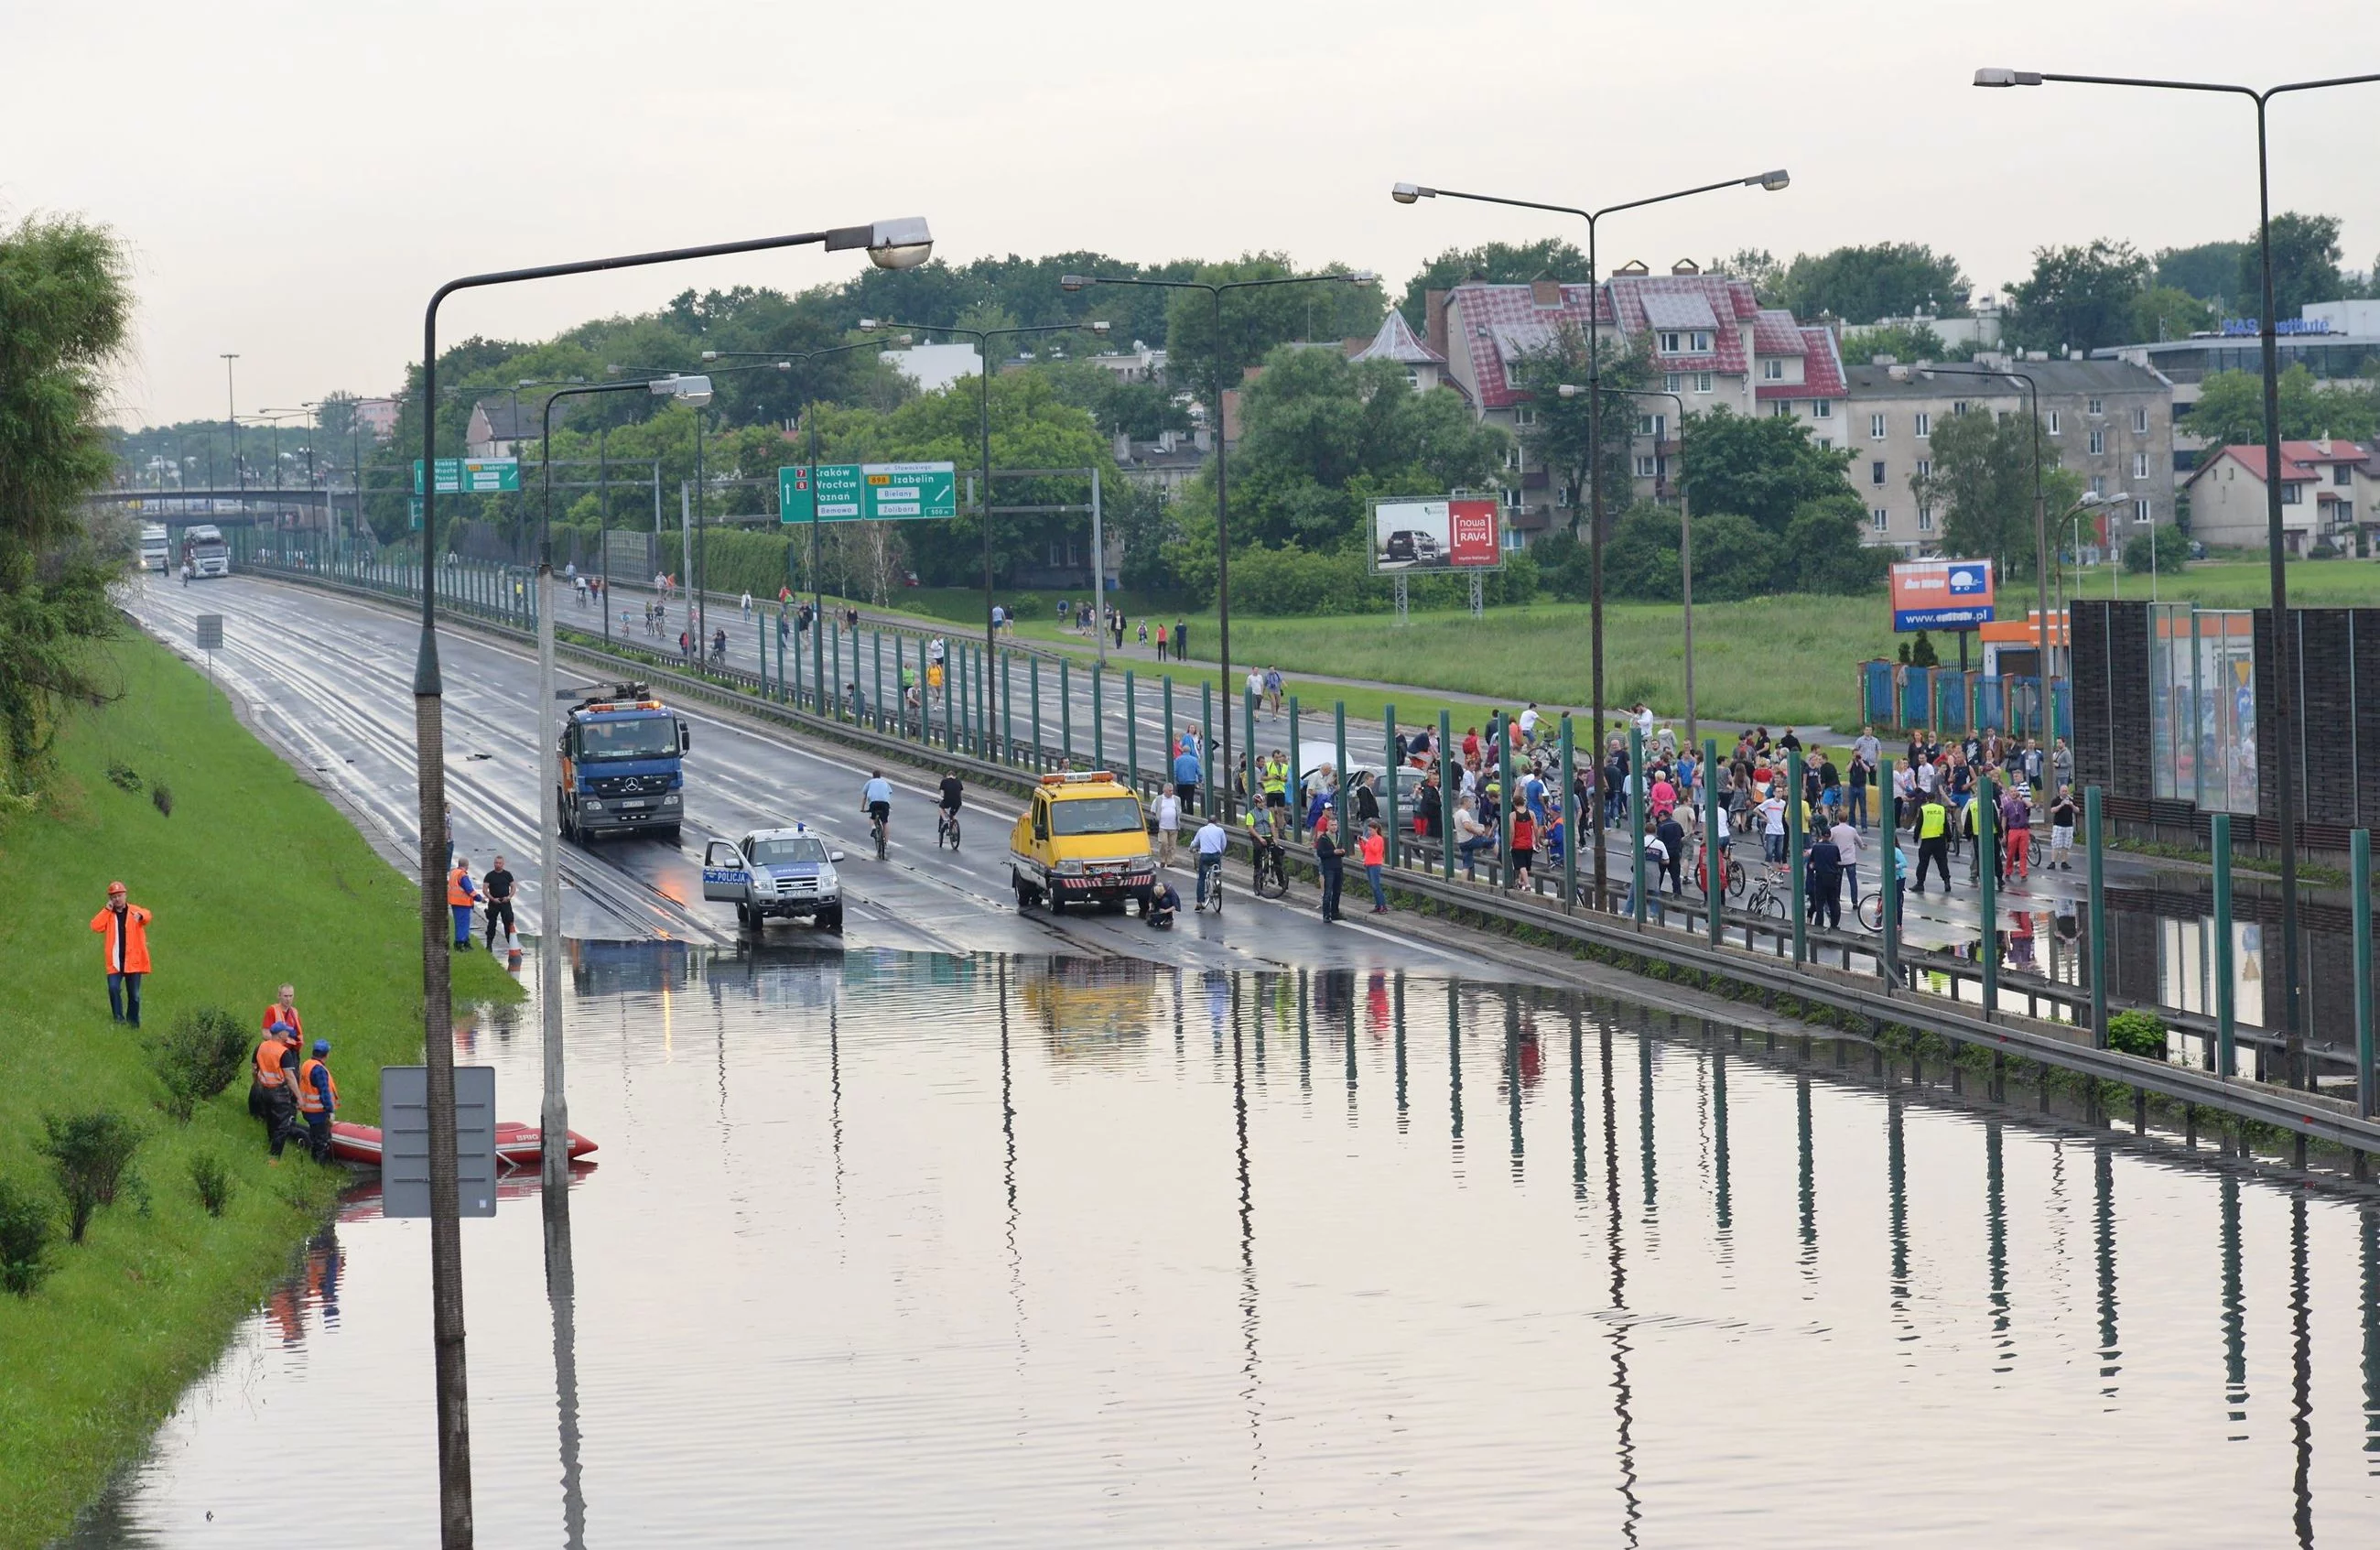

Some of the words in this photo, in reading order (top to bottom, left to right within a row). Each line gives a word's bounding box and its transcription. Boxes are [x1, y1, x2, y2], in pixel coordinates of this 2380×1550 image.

[2223, 319, 2257, 334] SAS
[2275, 317, 2330, 333] nstitute
[893, 474, 934, 483] Izabelin
[884, 490, 912, 498] Bielany
[1460, 519, 1486, 527] nowa
[1460, 532, 1488, 542] RAV4
[718, 872, 745, 883] POLICJA
